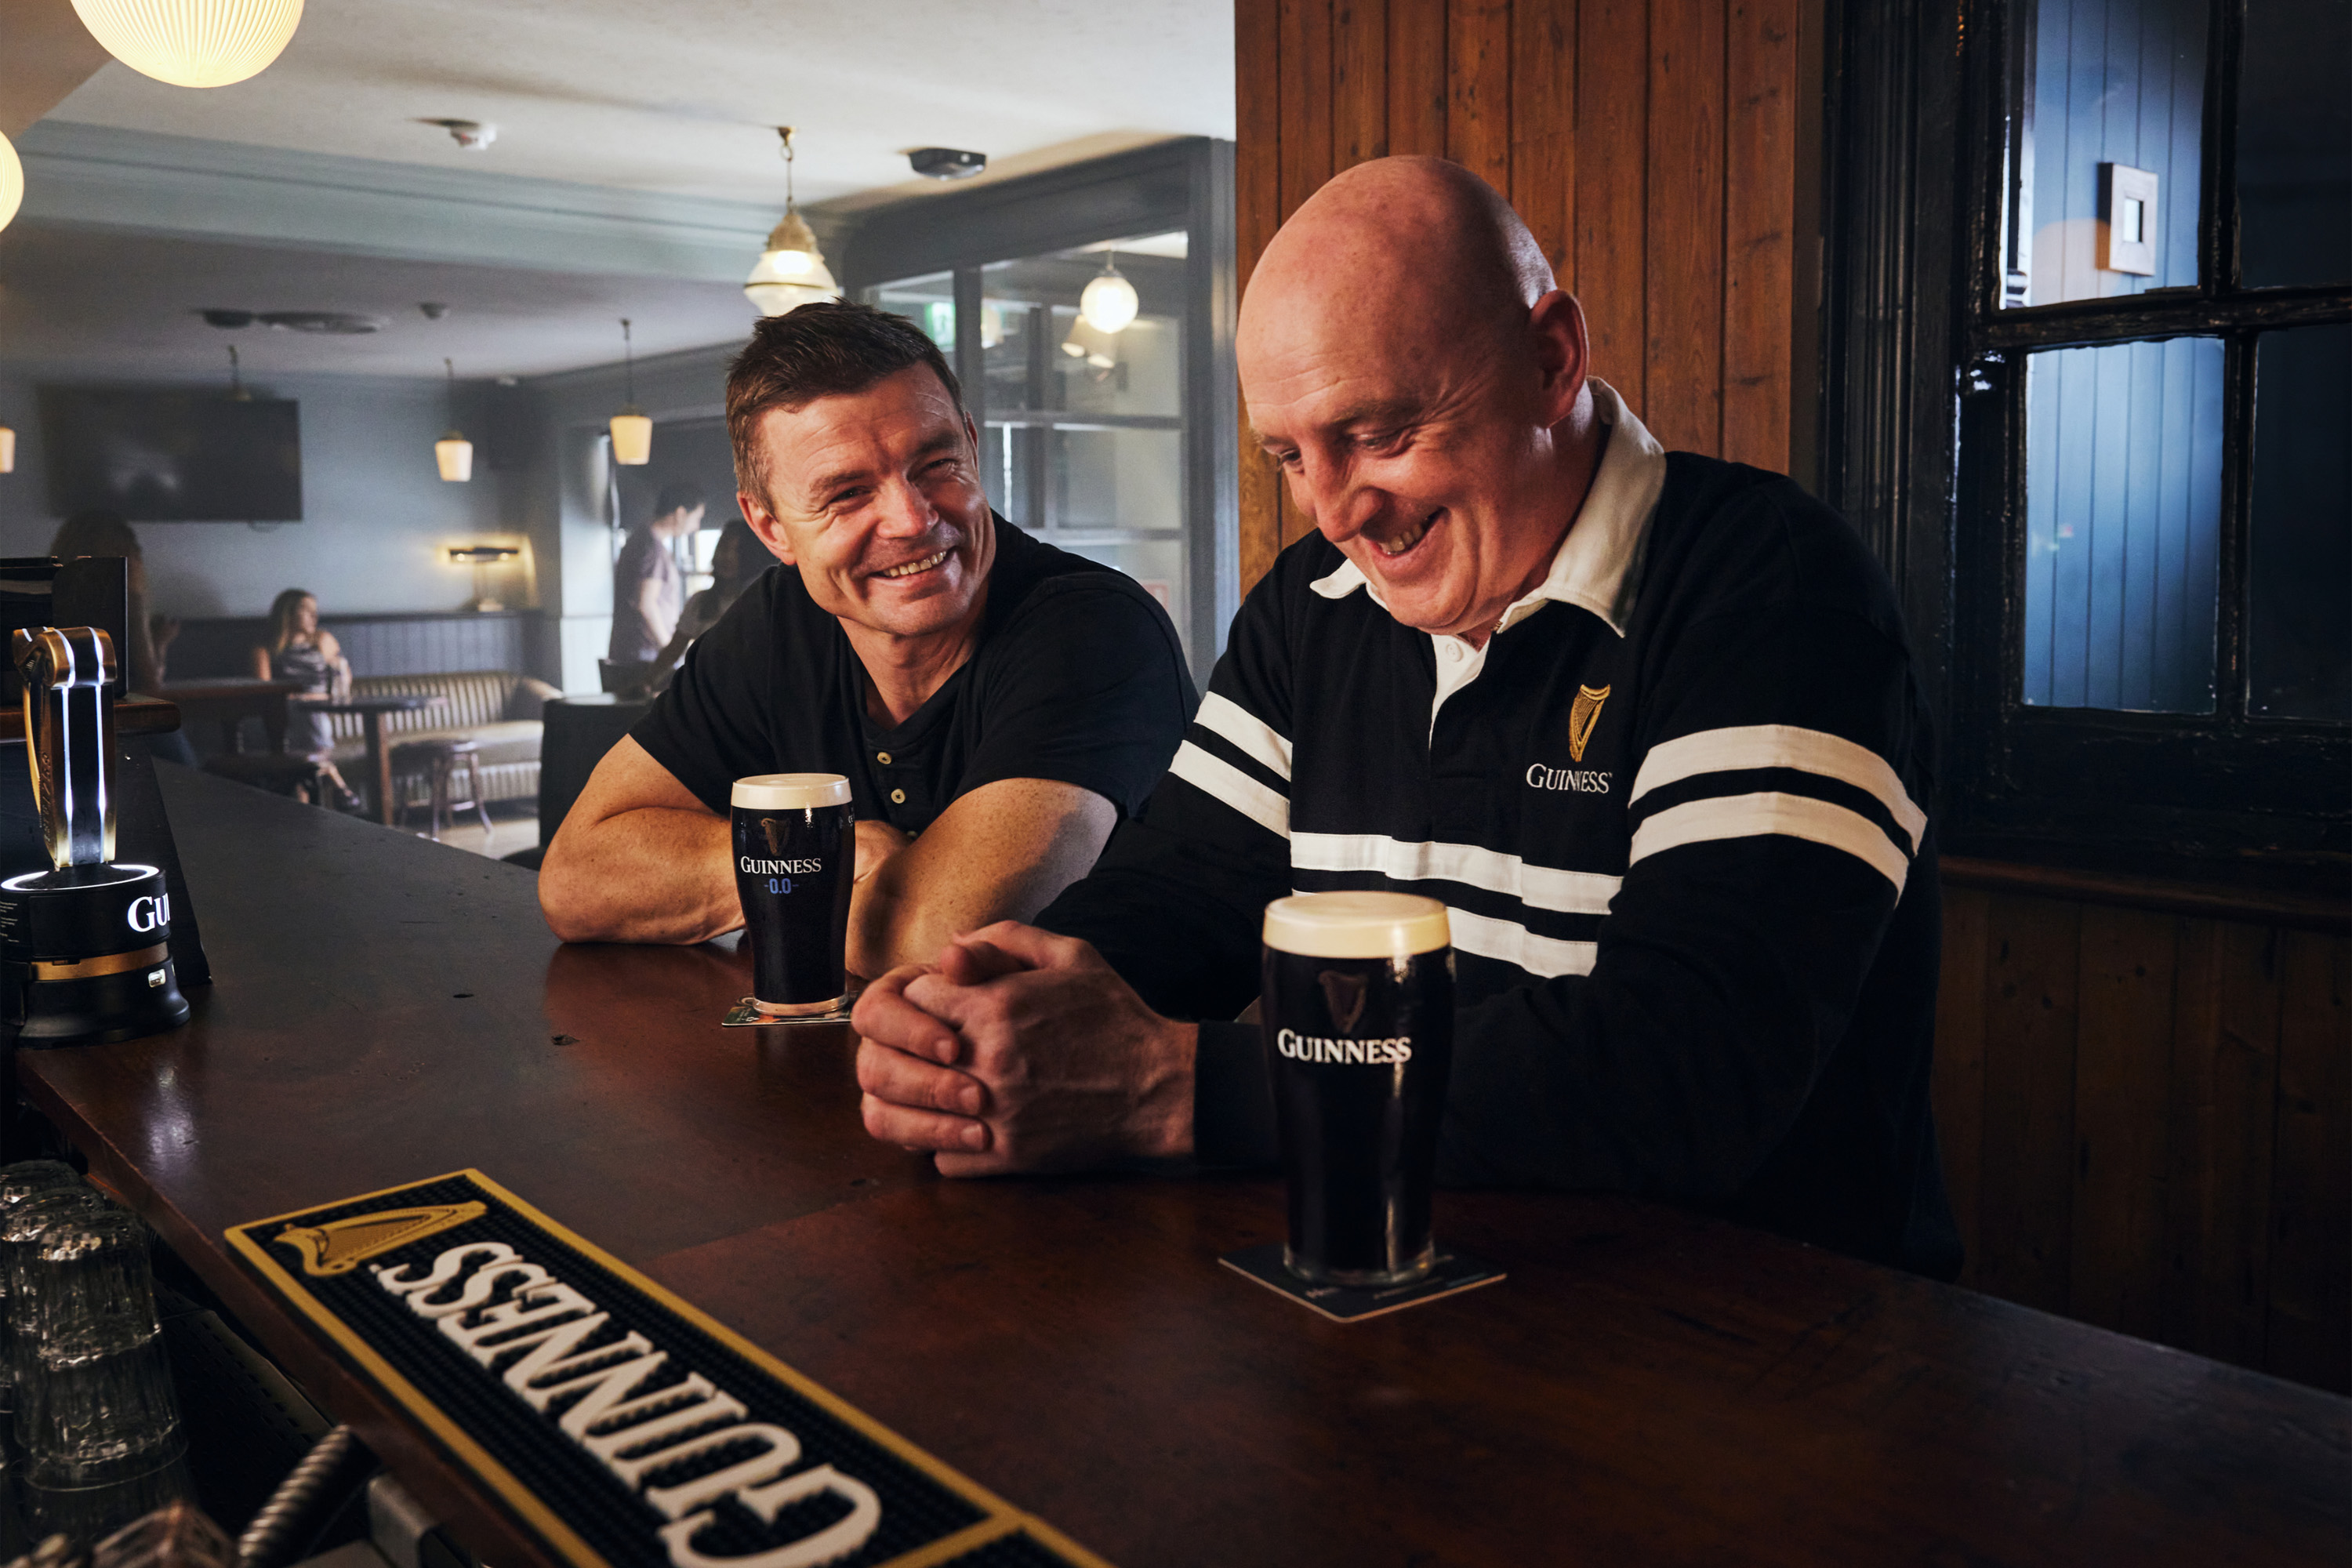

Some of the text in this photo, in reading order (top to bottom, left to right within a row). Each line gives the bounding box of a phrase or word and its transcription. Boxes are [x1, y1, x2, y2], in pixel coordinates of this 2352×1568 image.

[740, 855, 822, 874] GUINNESS
[1277, 1028, 1412, 1064] GUINNESS
[376, 1241, 882, 1568] GUINNESS
